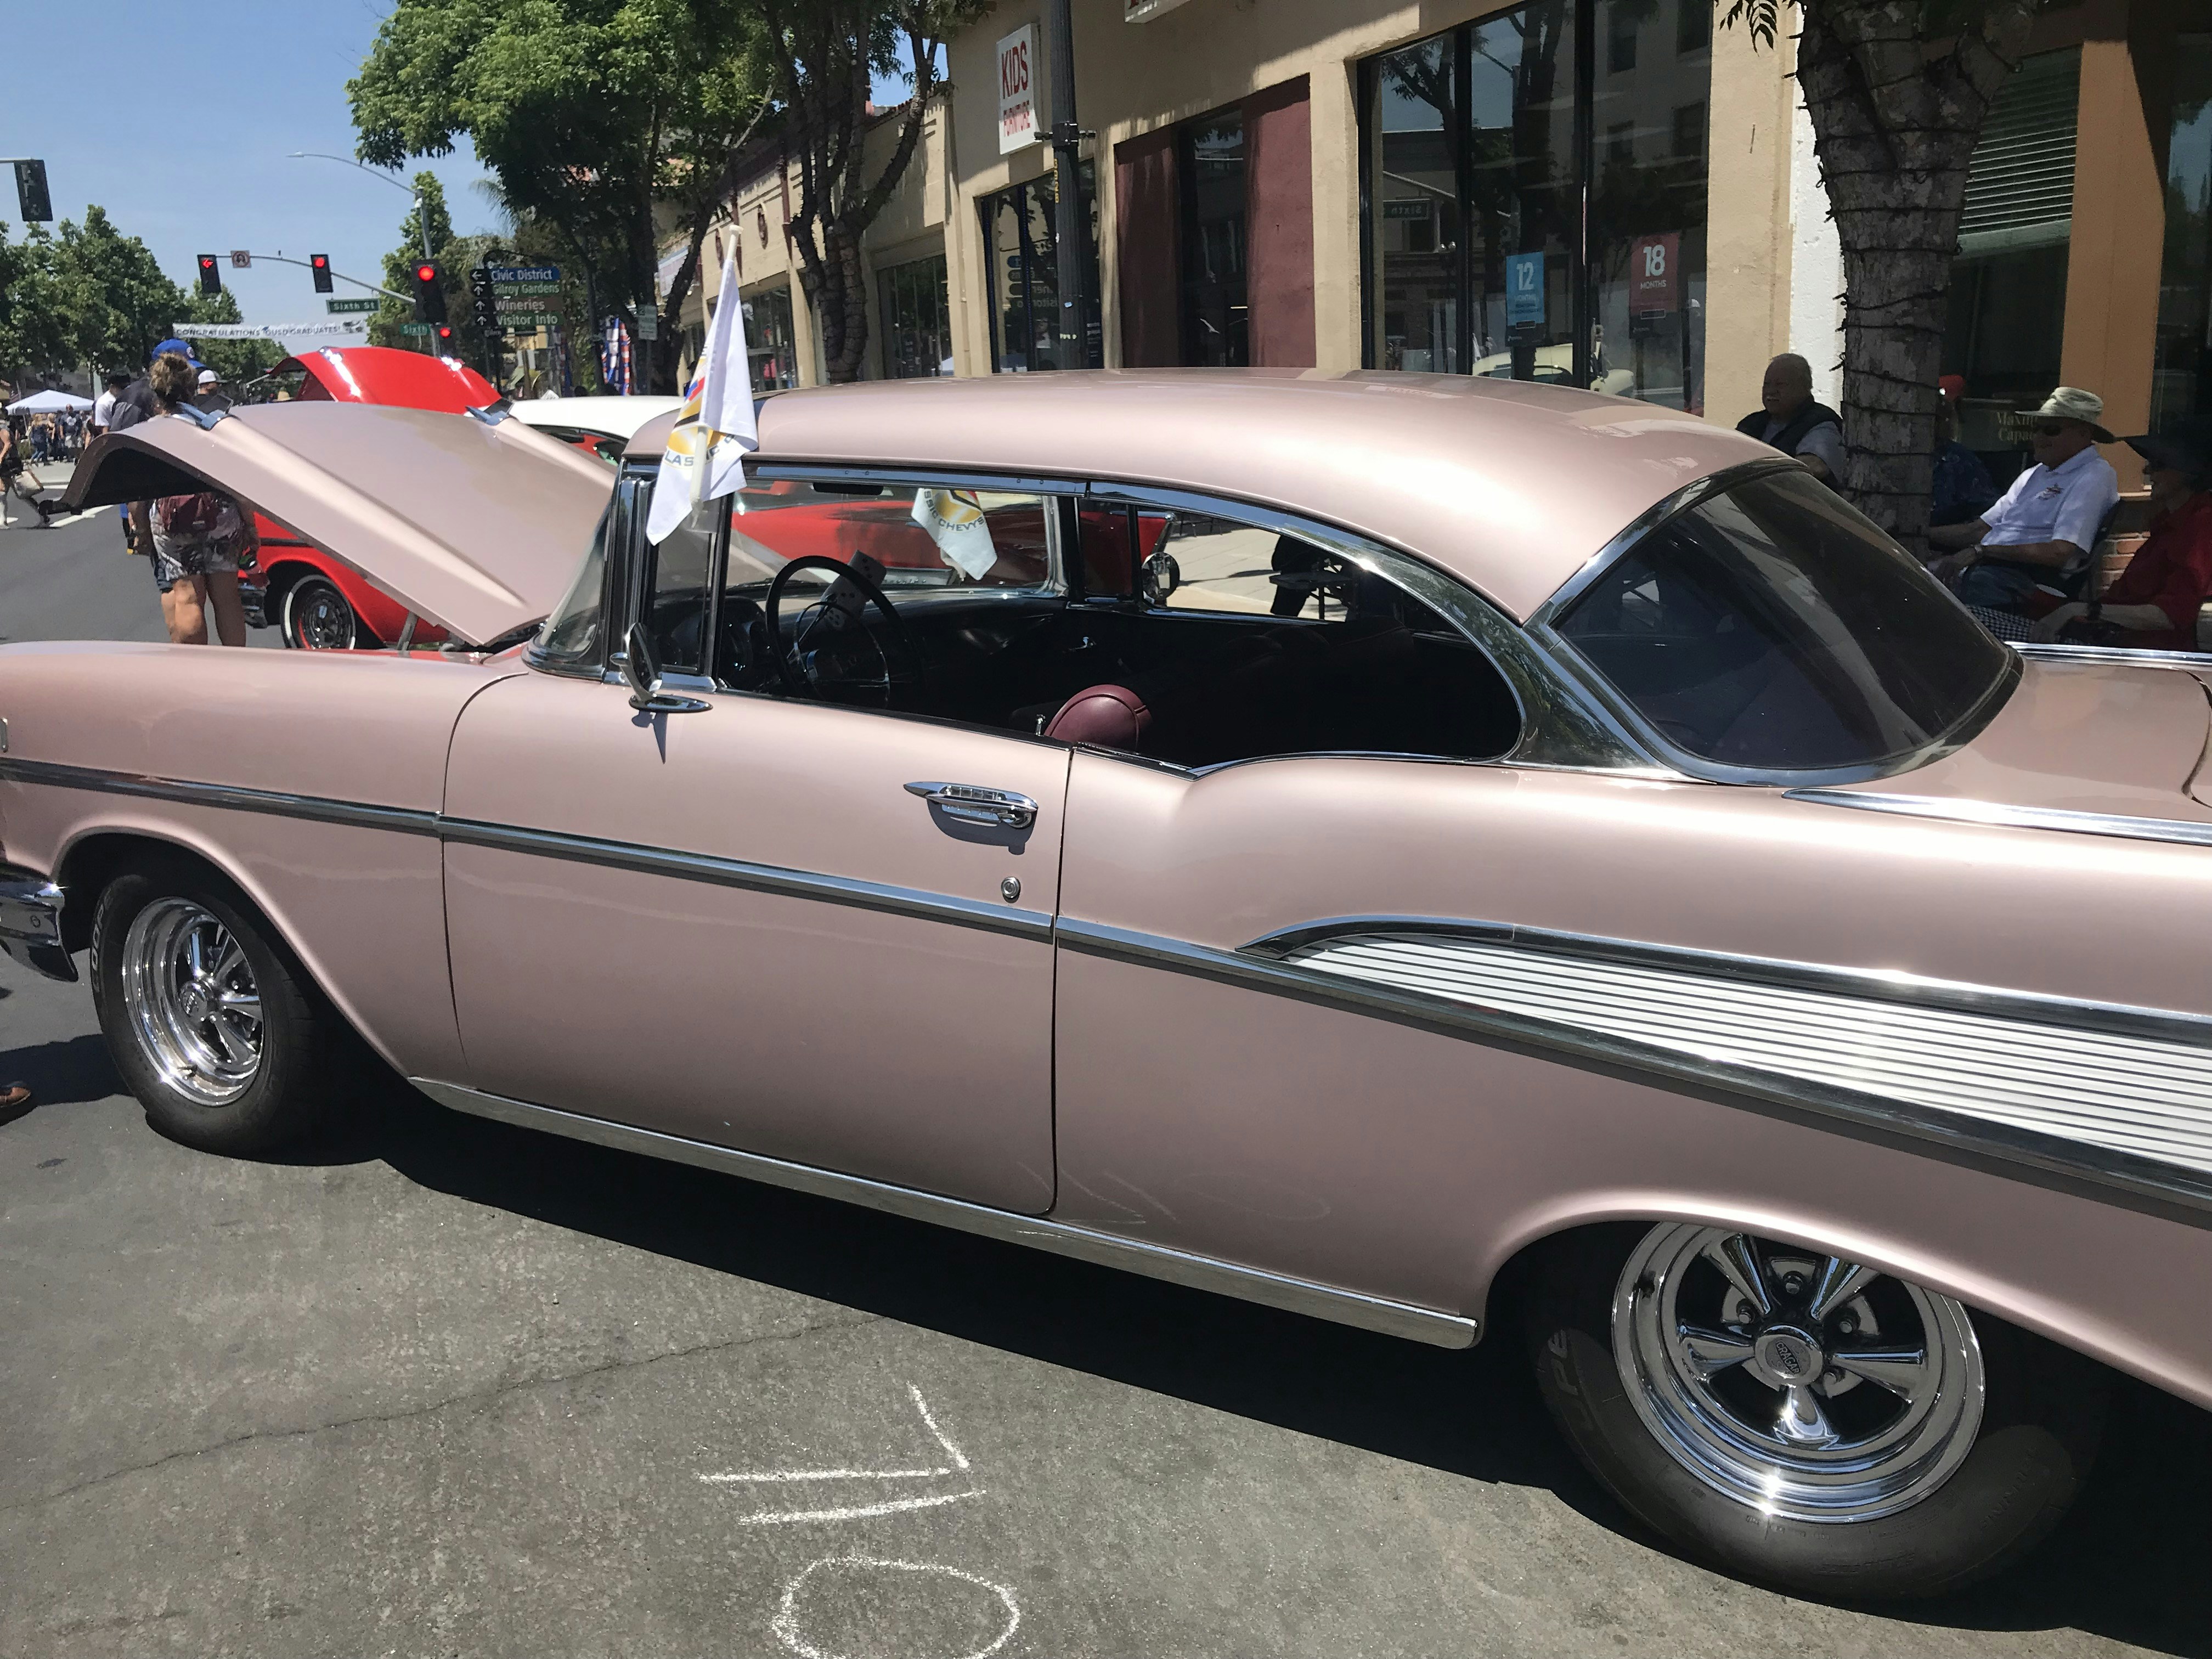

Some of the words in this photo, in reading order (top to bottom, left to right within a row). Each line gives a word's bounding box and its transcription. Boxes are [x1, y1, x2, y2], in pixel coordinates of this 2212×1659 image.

[1002, 40, 1028, 99] KIDS
[1643, 244, 1666, 277] 18
[490, 269, 515, 281] Civic
[517, 268, 552, 280] District
[1516, 261, 1534, 291] 12
[493, 284, 519, 296] Gilroy
[521, 283, 560, 294] Gardens
[1640, 279, 1667, 290] MONTHS
[333, 302, 360, 311] Sixth
[363, 301, 375, 310] St
[495, 299, 545, 311] Wineries
[496, 314, 532, 326] Visitor
[535, 313, 558, 325] Info
[403, 324, 428, 334] Sixth
[939, 516, 984, 532] CHEVYS
[1775, 1341, 1801, 1374] CRAGAR
